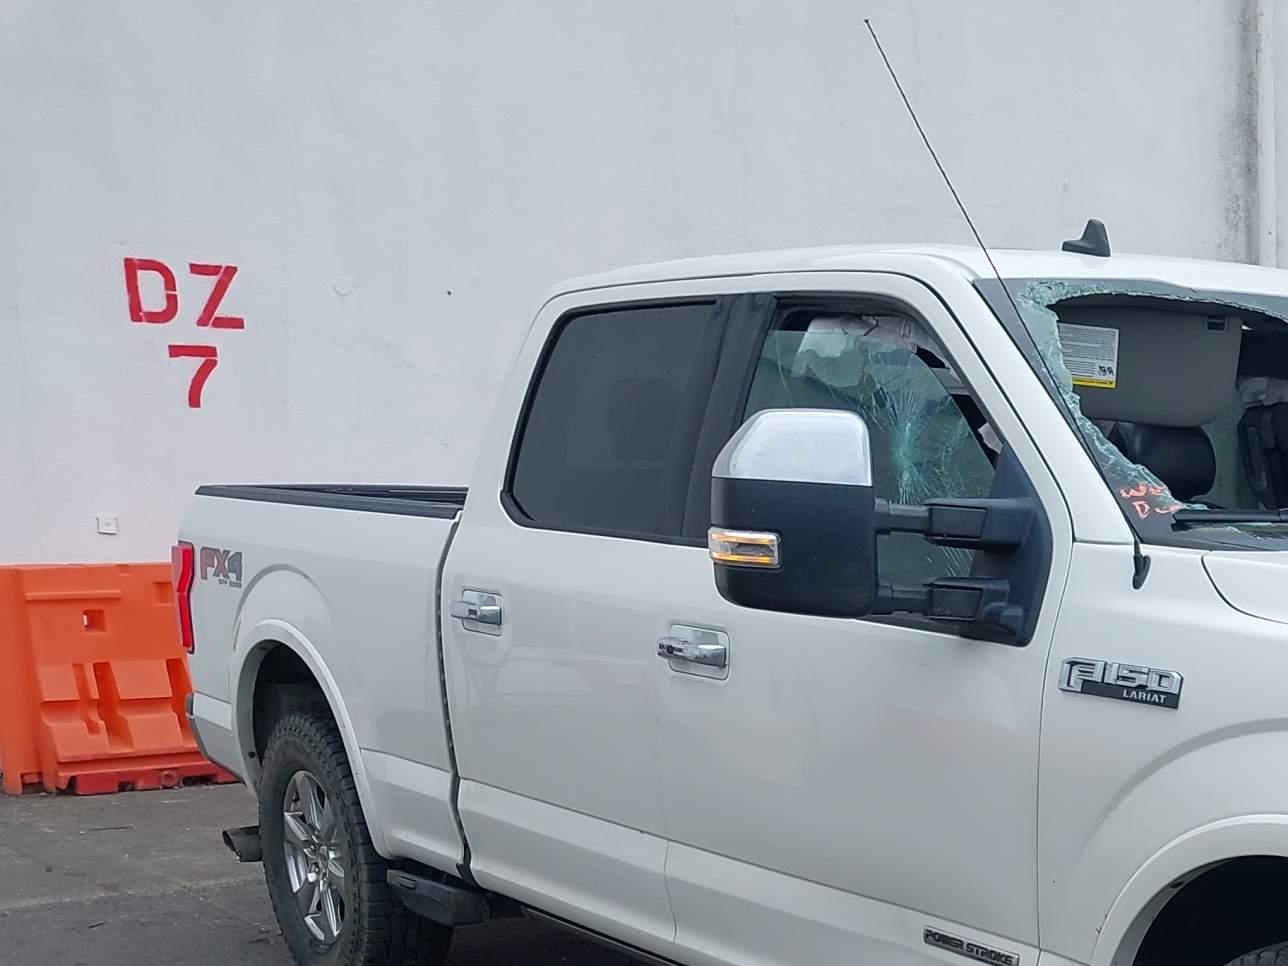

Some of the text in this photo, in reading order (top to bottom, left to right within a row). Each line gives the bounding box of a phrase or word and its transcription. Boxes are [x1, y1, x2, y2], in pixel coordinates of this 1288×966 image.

[122, 256, 246, 331] DZ
[167, 343, 219, 409] 7
[200, 546, 243, 581] FX4
[1122, 689, 1168, 704] LARIAT
[966, 942, 1014, 966] STROKE
